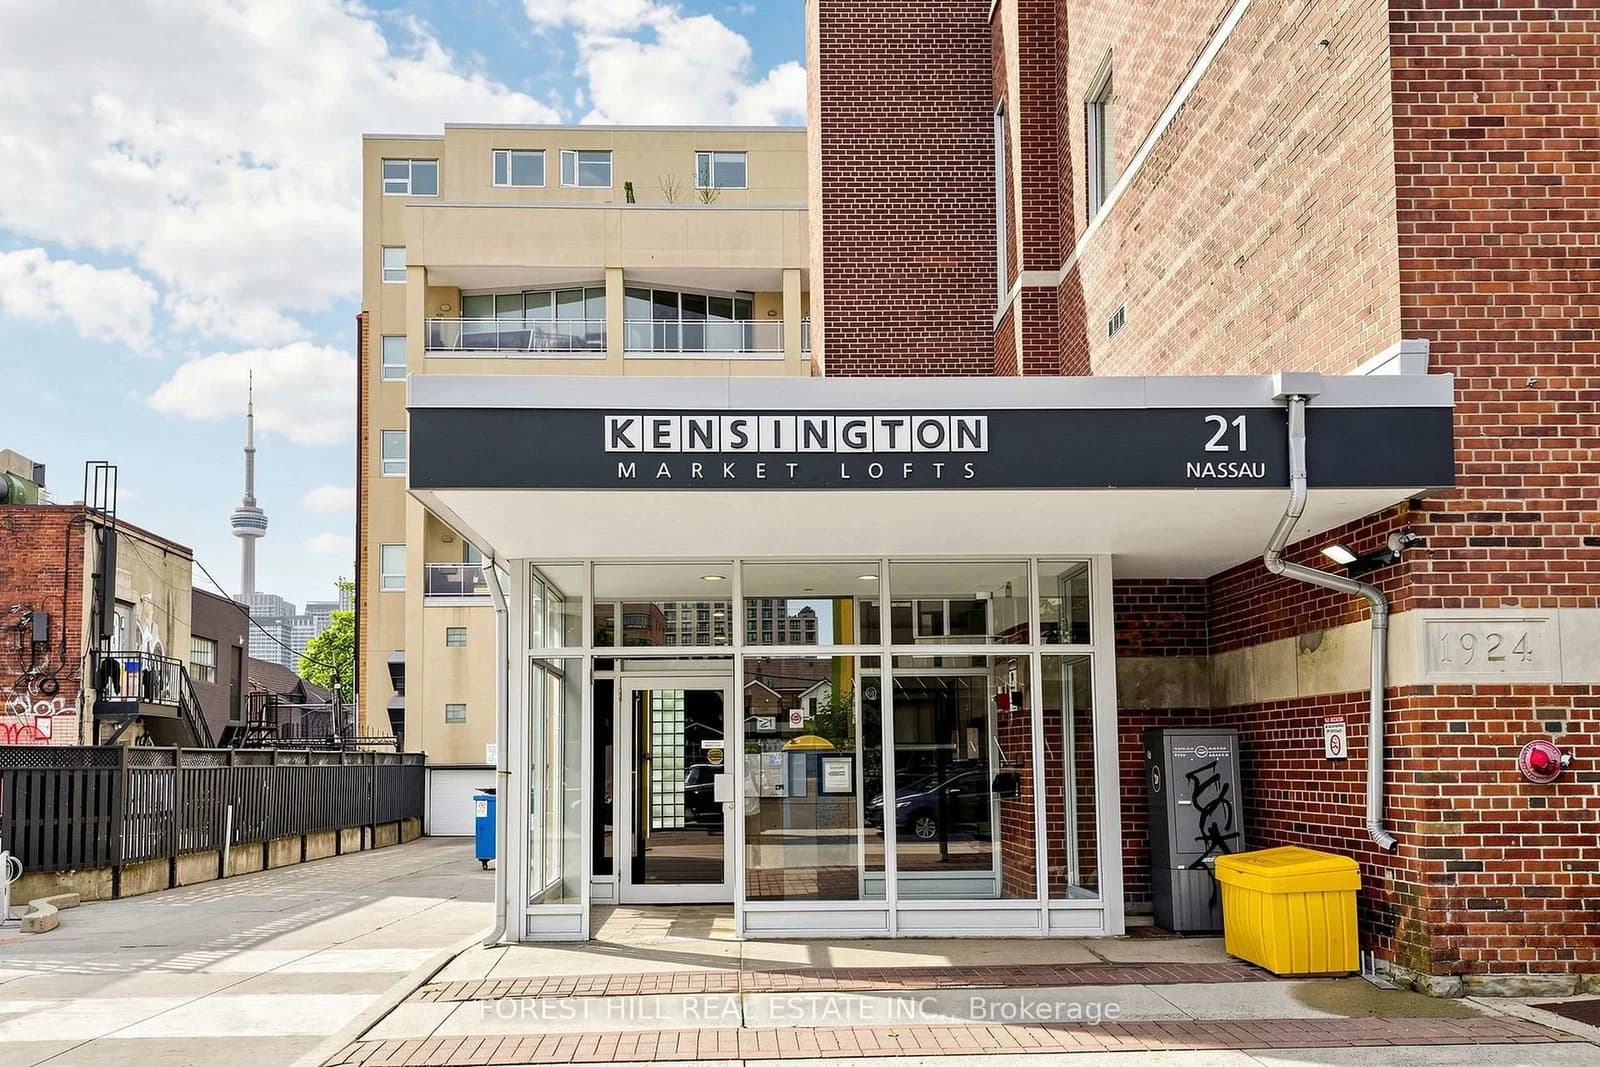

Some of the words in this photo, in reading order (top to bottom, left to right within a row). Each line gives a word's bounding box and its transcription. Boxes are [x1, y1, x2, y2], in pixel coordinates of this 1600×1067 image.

[609, 417, 984, 450] KENSINGTON
[1204, 414, 1247, 452] 21
[618, 462, 799, 480] MARKET
[840, 462, 975, 480] LOFTS
[1186, 462, 1266, 479] NASSAU
[1440, 631, 1533, 666] 1924
